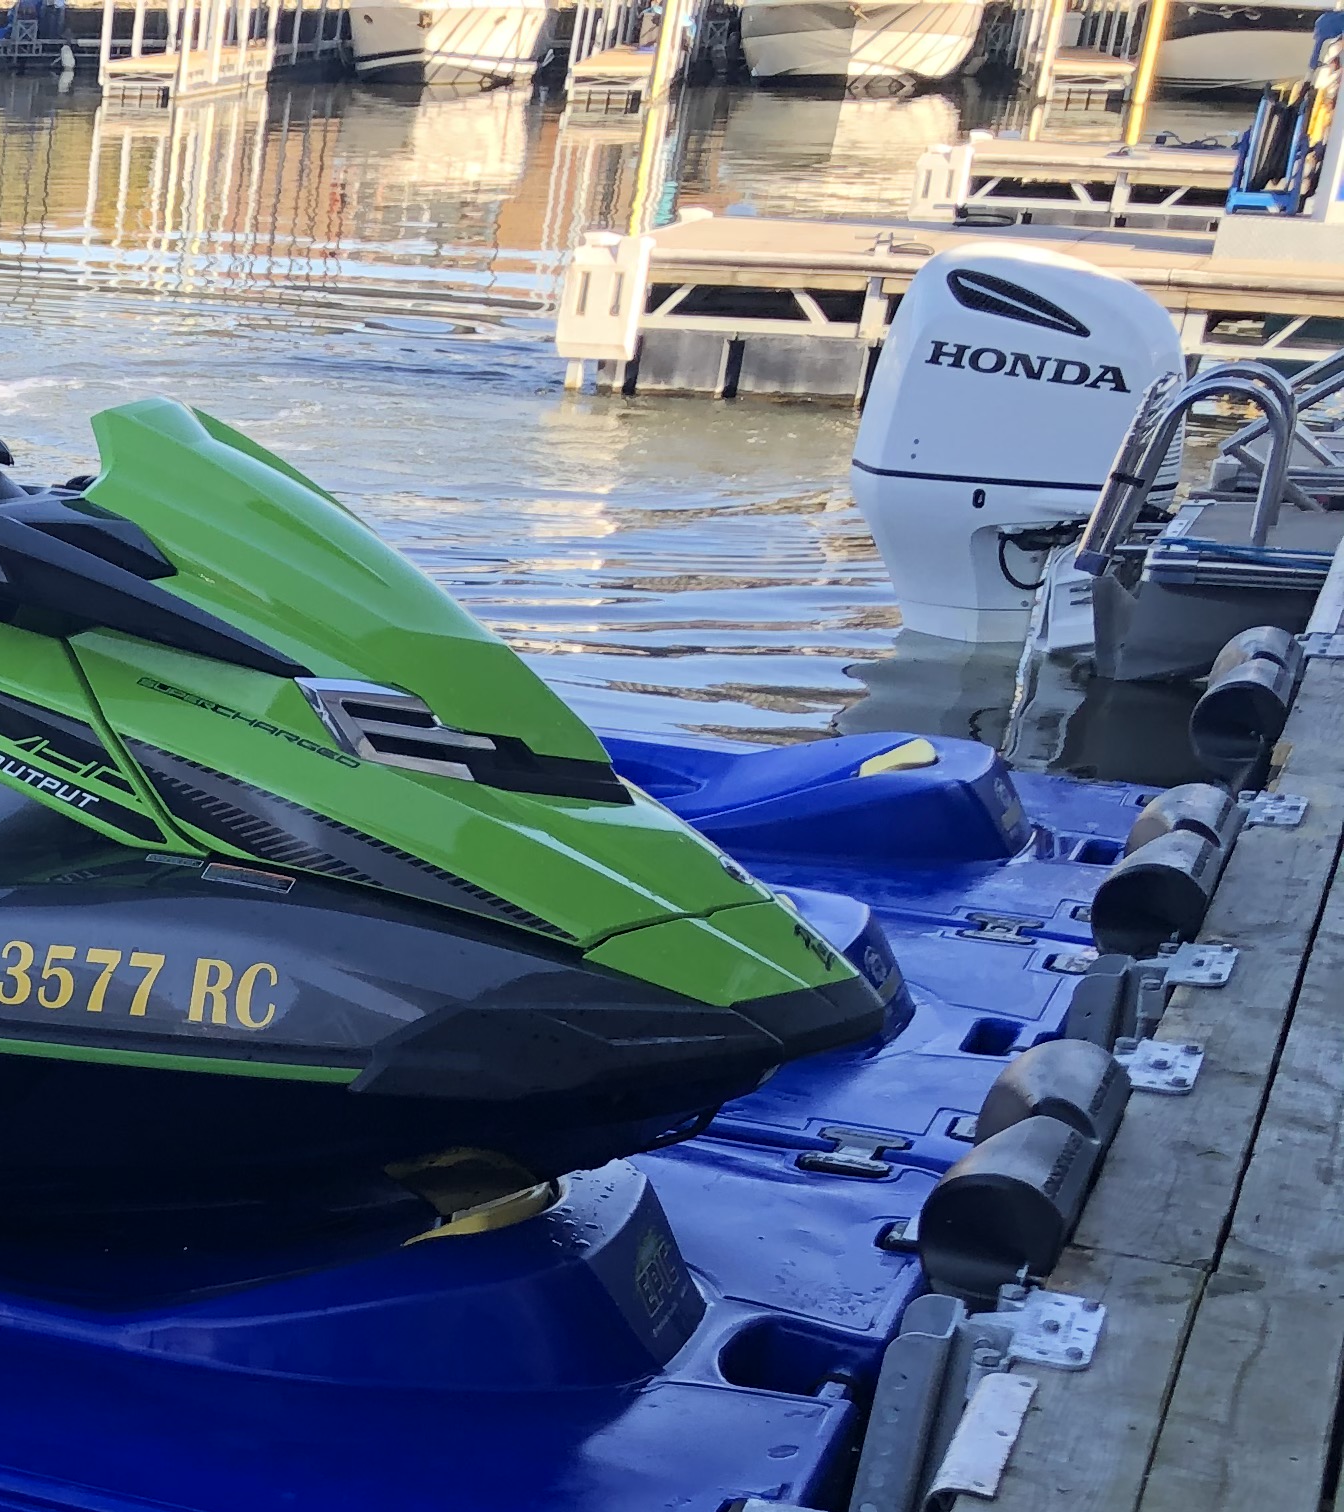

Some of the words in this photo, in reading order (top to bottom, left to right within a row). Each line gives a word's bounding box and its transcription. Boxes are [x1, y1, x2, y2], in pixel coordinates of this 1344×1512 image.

[924, 340, 1132, 394] HONDA
[135, 676, 362, 769] SUPERCHARGED
[187, 957, 279, 1030] RC
